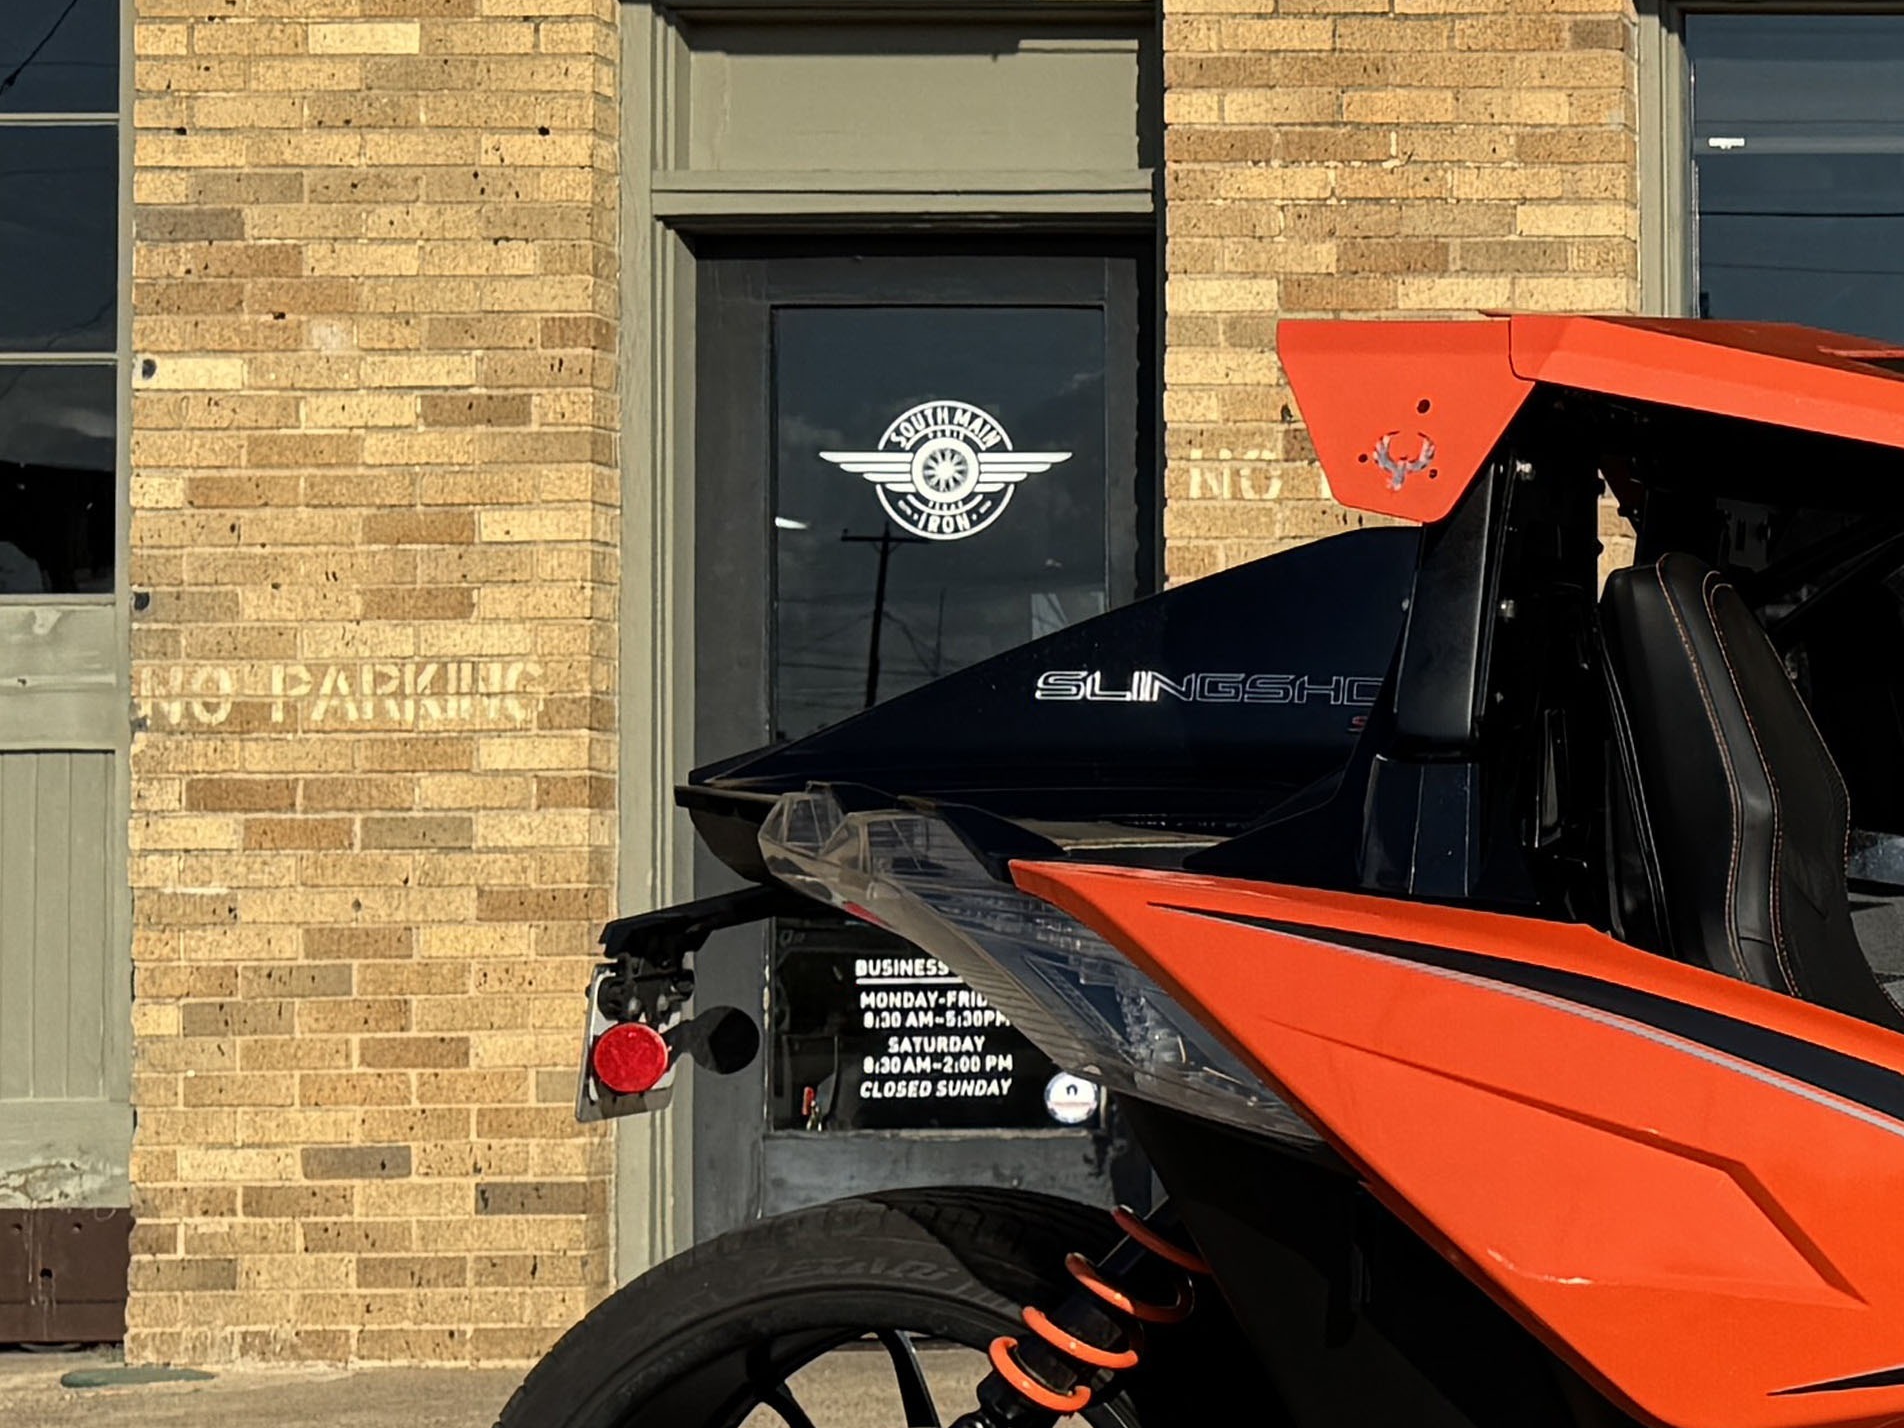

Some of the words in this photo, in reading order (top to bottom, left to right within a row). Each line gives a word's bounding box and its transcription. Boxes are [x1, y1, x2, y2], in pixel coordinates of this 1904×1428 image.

[890, 406, 949, 448] SOUTH
[953, 408, 1001, 449] MAIN
[1189, 448, 1282, 500] NO
[918, 512, 980, 533] IRON
[140, 665, 233, 725] NO
[271, 662, 544, 724] PARKING
[855, 958, 950, 976] BUSINESS
[888, 1035, 985, 1053] SATURDAY
[985, 1054, 1013, 1072] PM
[860, 1080, 932, 1098] CLOSED
[935, 1078, 1012, 1097] SUNDAY
